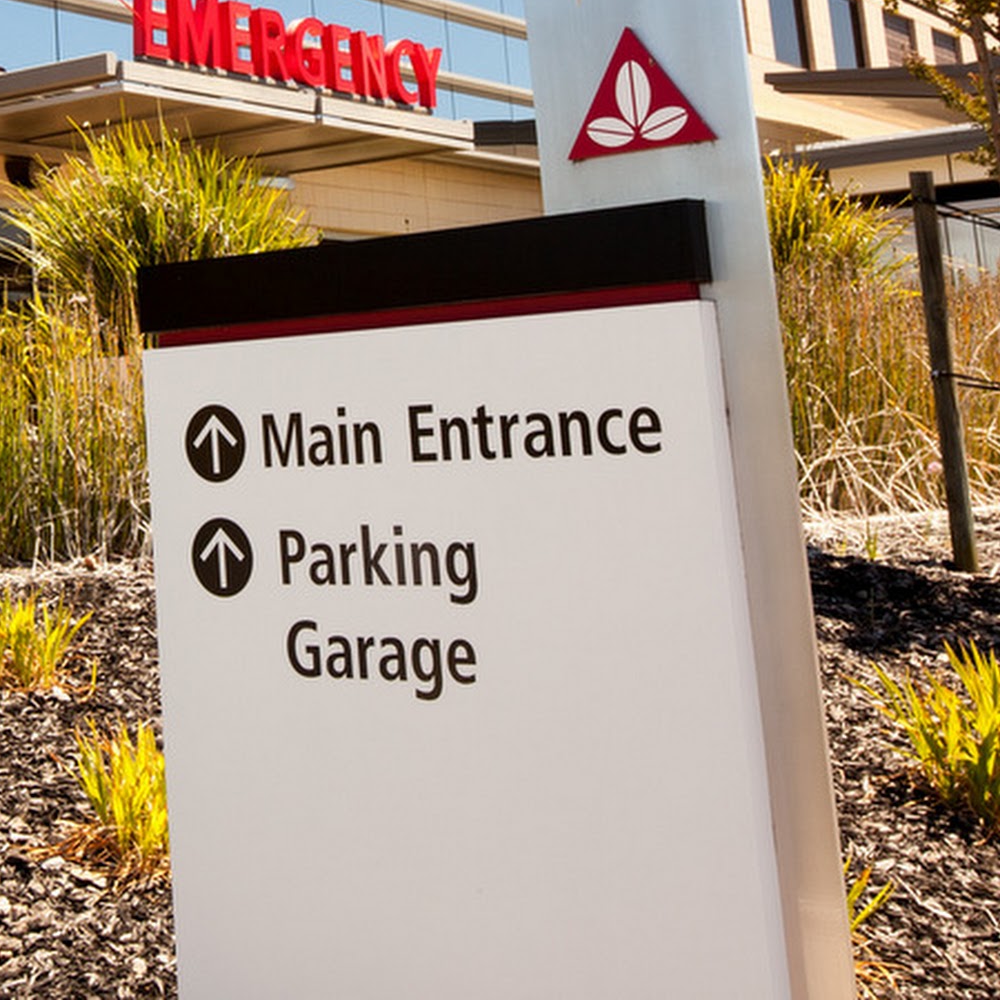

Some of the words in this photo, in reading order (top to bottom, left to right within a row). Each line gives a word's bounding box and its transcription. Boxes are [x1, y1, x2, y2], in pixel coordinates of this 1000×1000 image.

[261, 406, 383, 468] Main
[407, 404, 662, 463] Entrance
[279, 524, 478, 605] Parking
[286, 619, 477, 701] Garage
